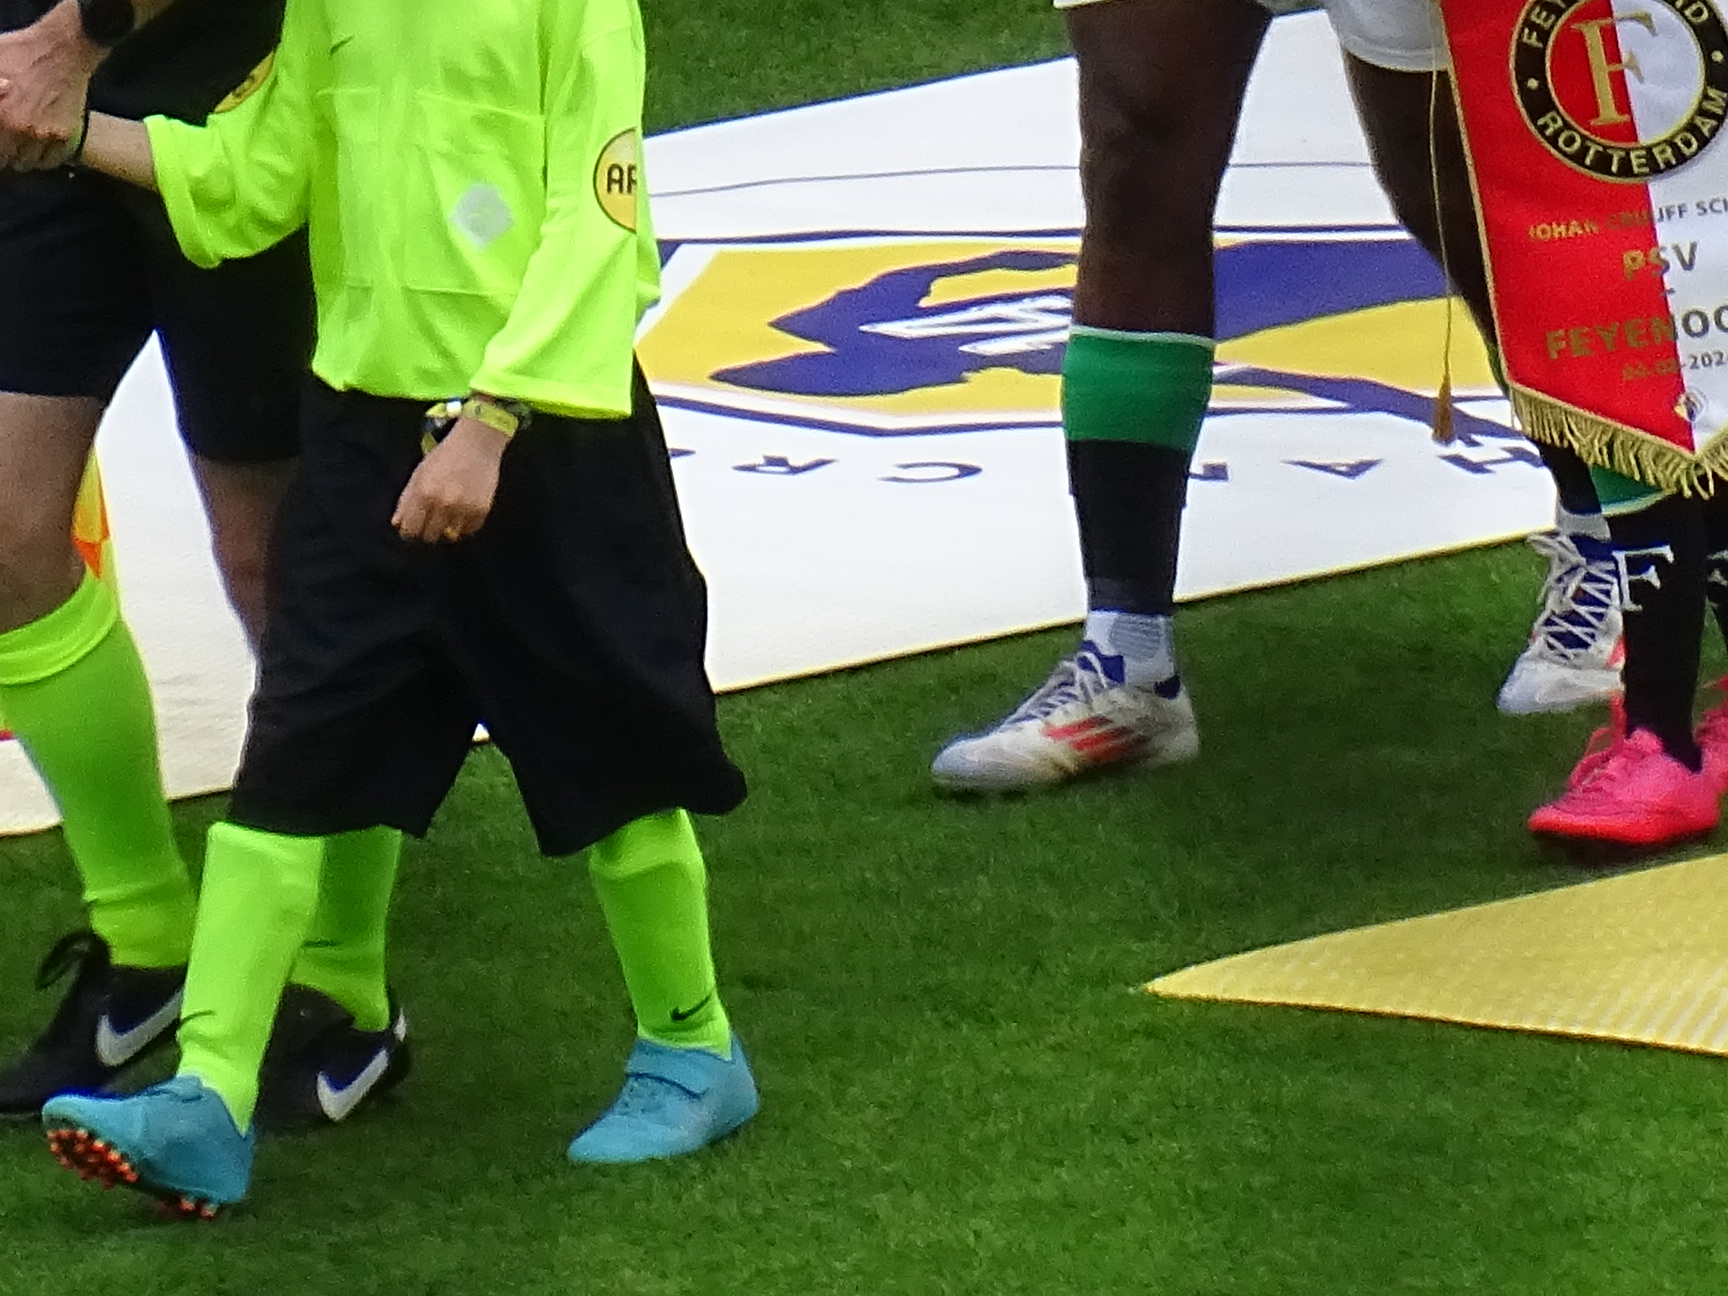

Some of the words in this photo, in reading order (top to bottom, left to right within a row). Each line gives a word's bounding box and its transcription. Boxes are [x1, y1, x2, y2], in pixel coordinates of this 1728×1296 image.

[1570, 8, 1659, 127] F
[1622, 240, 1698, 282] PSV
[1611, 544, 1674, 613] F
